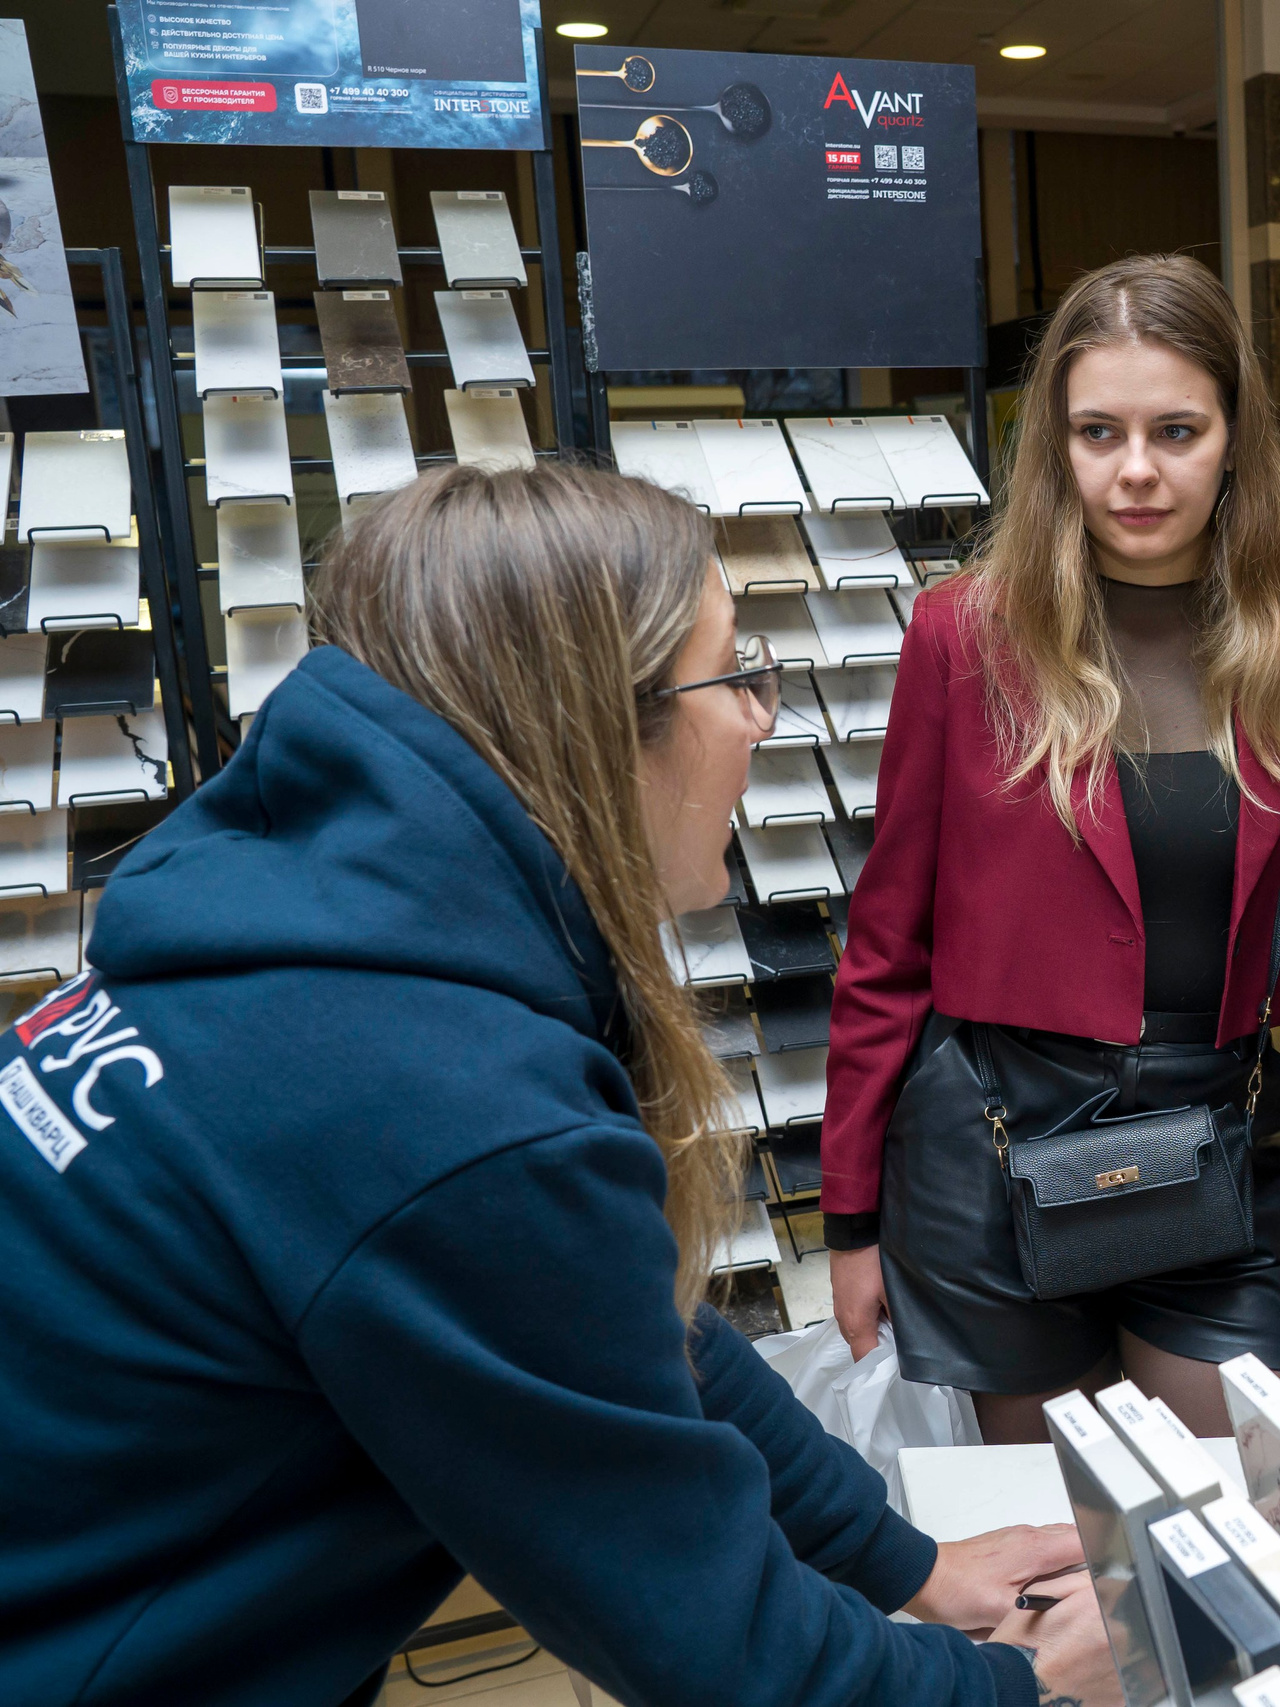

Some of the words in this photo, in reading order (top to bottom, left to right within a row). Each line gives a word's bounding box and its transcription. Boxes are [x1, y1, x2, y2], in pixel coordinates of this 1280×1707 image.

[160, 16, 194, 24] ВЫСОКОЕ
[161, 29, 221, 38] ДЕЙСТВИТЕЛЬНО
[163, 43, 211, 51] ПОПУЛЯРНЫЕ
[182, 88, 228, 97] БЕССРОЧНАЯ
[342, 87, 360, 95] 499
[194, 97, 255, 105] ПРОИЗВОДИТЕЛЯ
[824, 71, 924, 129] AVANT
[434, 98, 530, 113] INTERSTONE
[877, 114, 924, 130] quartz
[839, 155, 858, 163] ЛЕТ
[872, 190, 926, 199] INTERSTONE
[14, 971, 164, 1132] РУС
[26, 1102, 71, 1160] КВАРЦ
